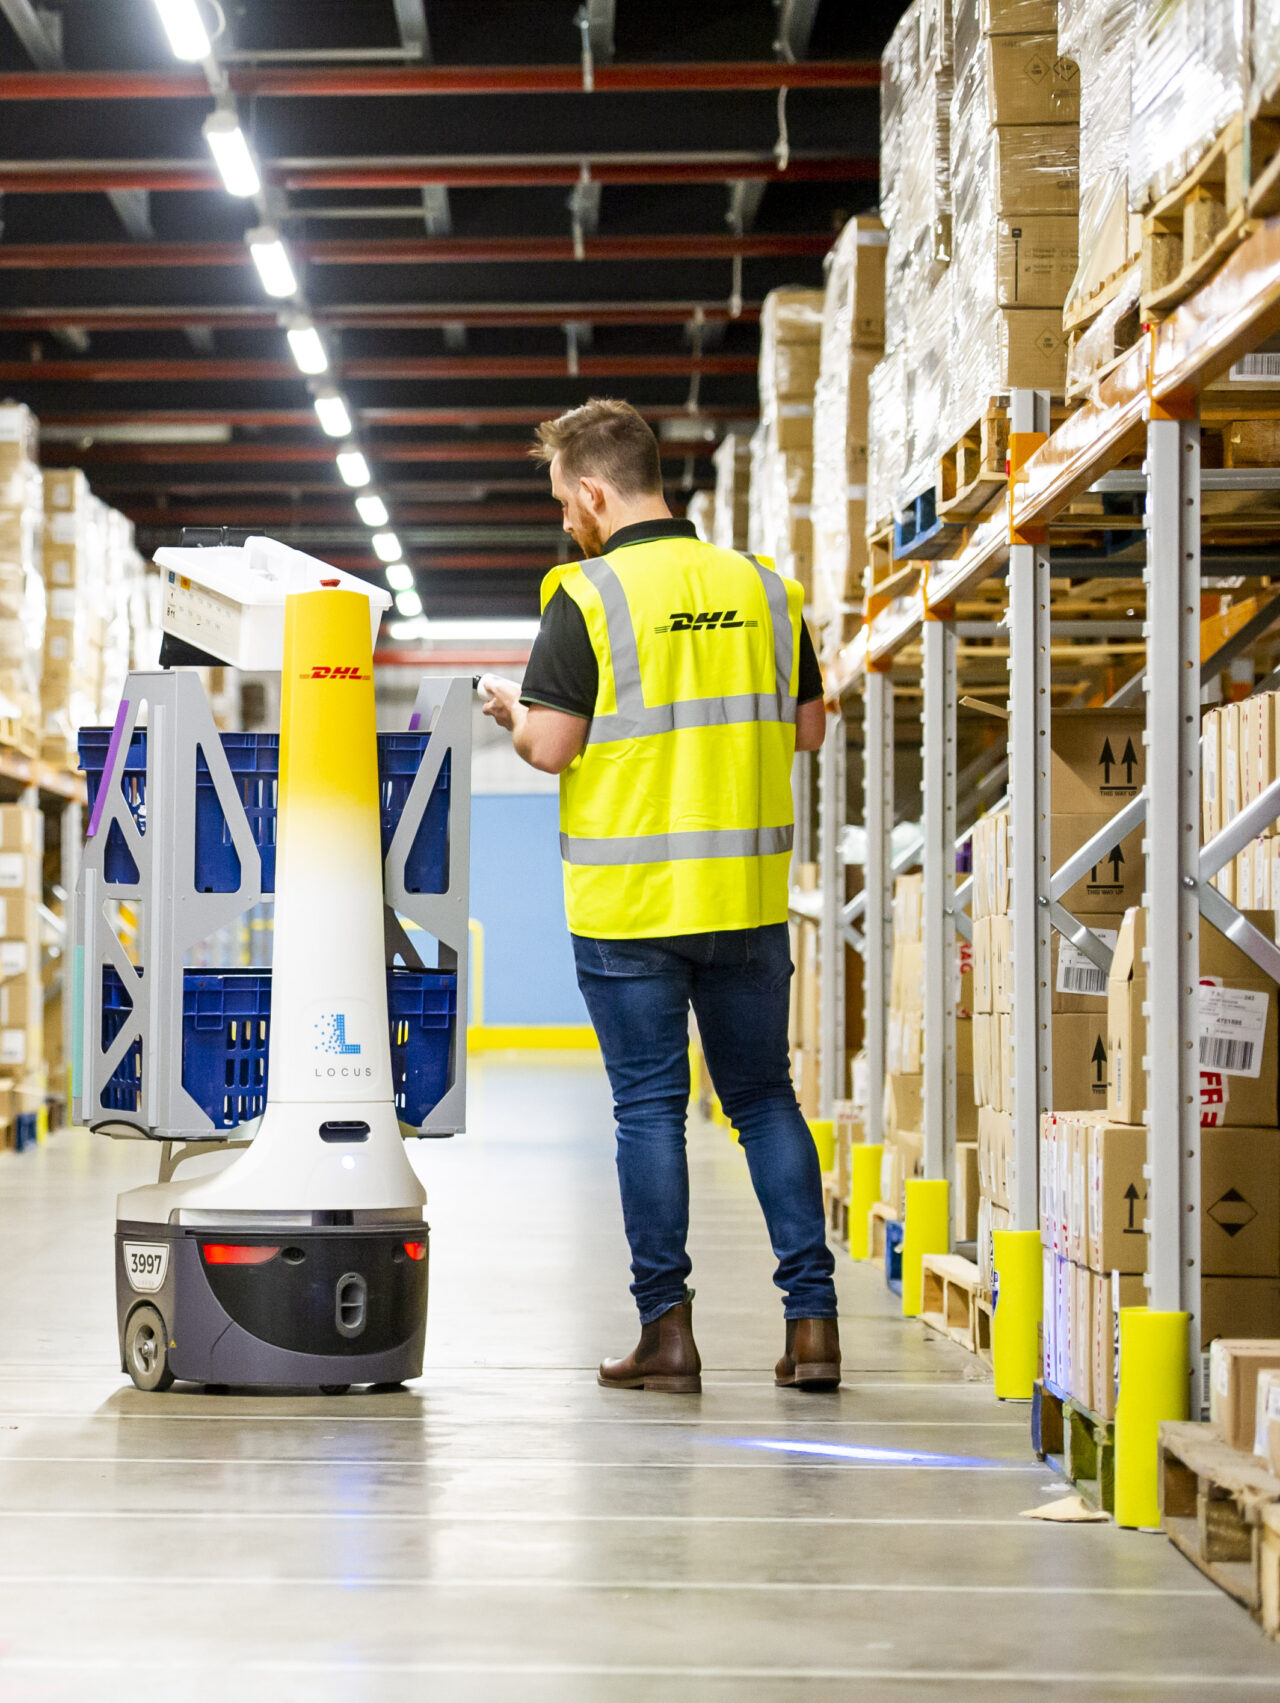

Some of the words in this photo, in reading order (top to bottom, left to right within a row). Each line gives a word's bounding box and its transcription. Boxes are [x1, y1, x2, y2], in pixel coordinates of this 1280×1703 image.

[669, 610, 745, 632] DHL
[310, 666, 362, 680] DHL
[315, 1067, 372, 1077] LOCUS
[131, 1253, 162, 1275] 3997
